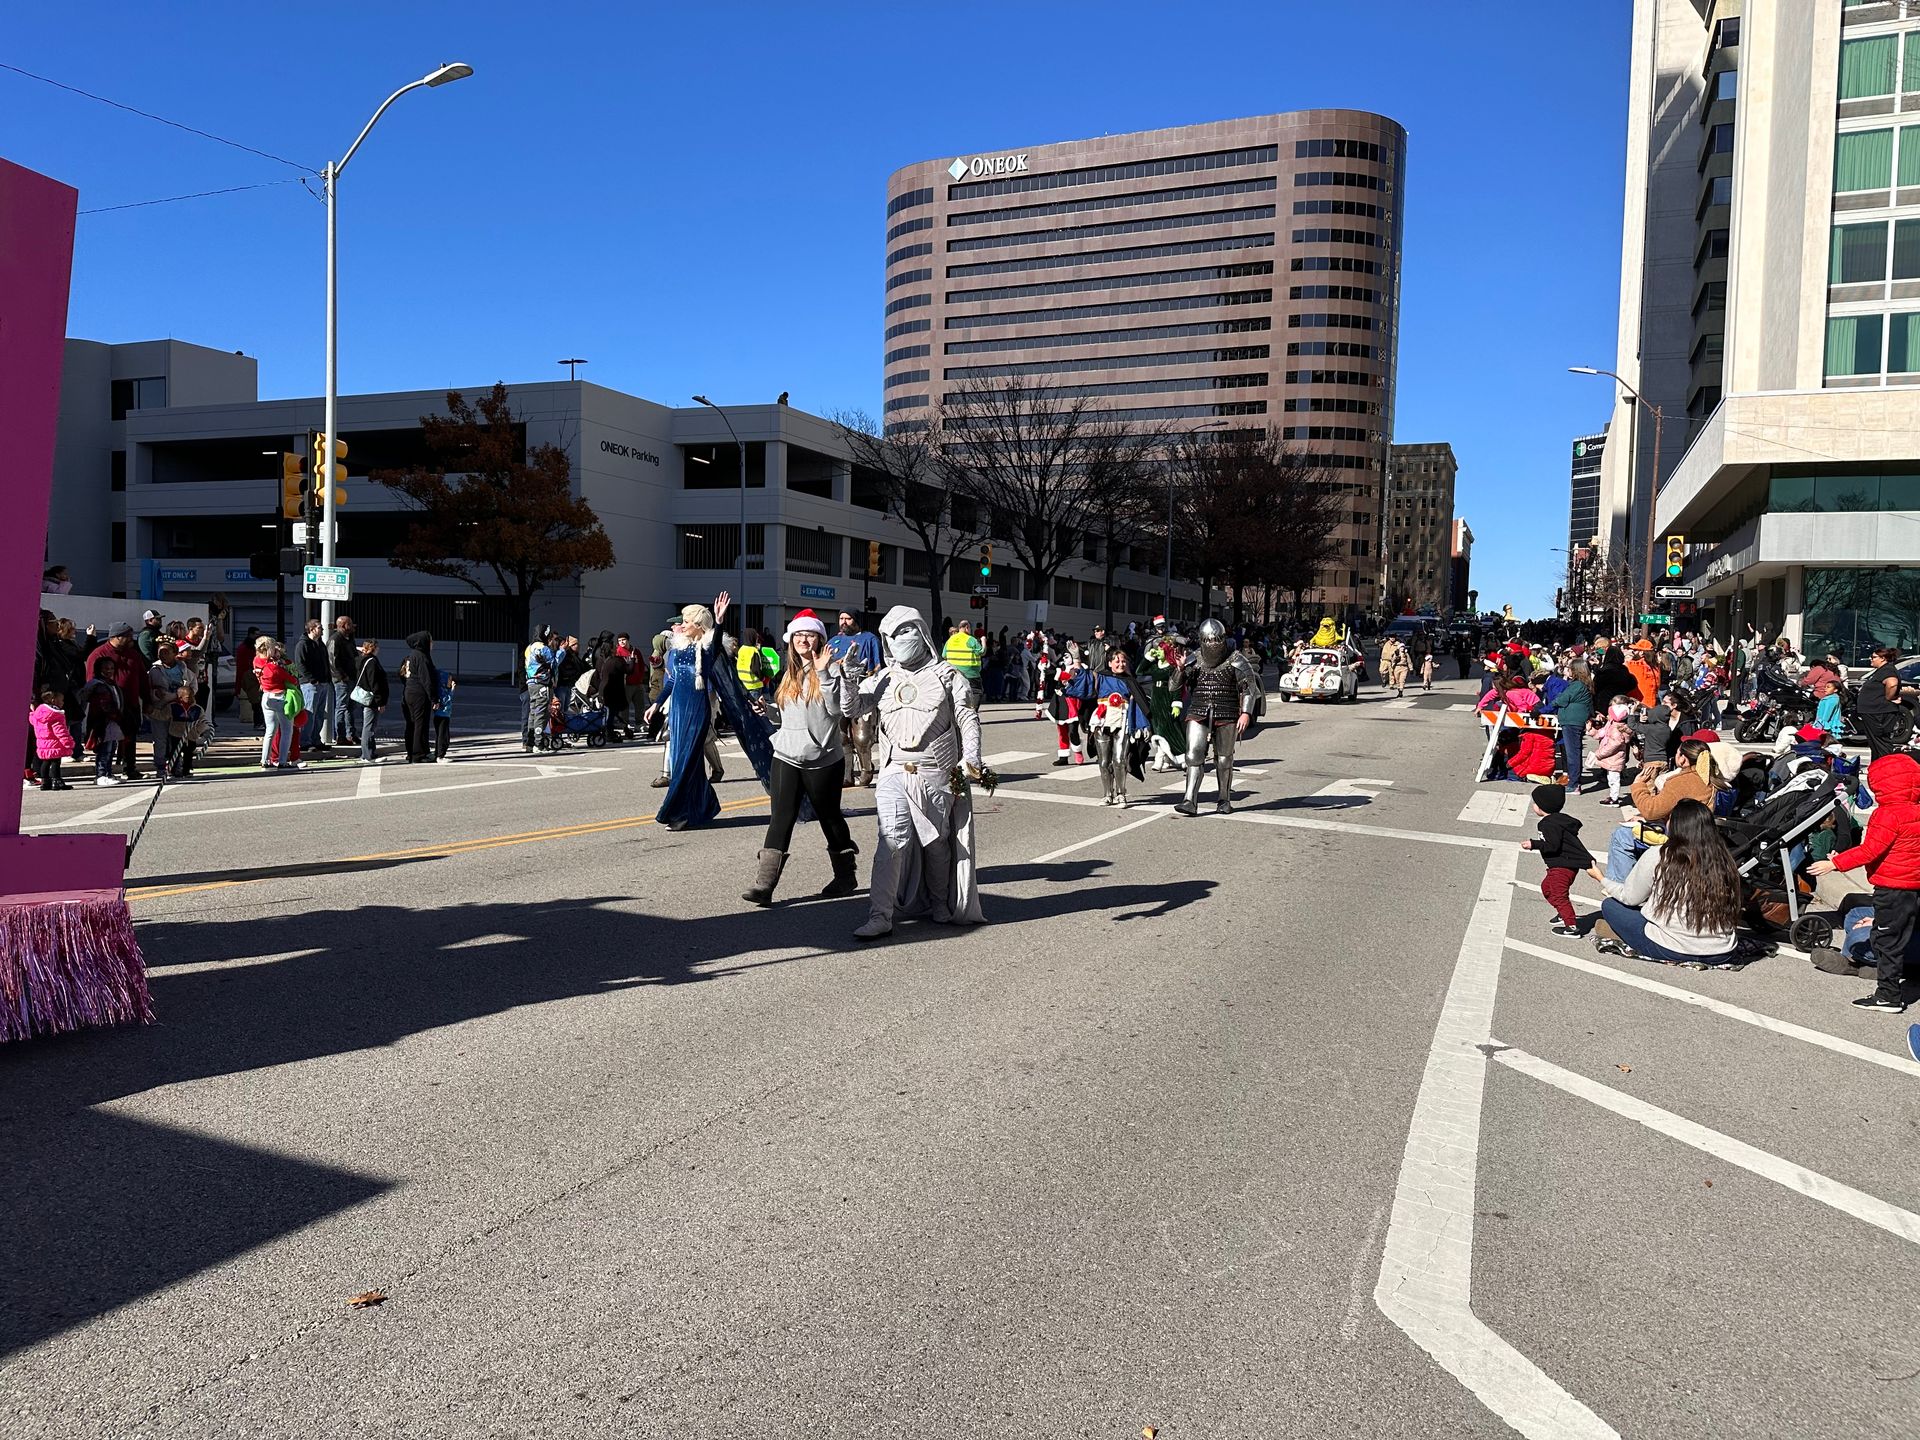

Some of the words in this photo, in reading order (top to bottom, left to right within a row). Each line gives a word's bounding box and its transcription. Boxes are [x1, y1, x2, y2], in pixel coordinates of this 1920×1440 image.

[971, 154, 1028, 177] ONEOK
[600, 440, 630, 457] ONEOK
[631, 448, 660, 467] Parking
[172, 571, 189, 579] ONLY
